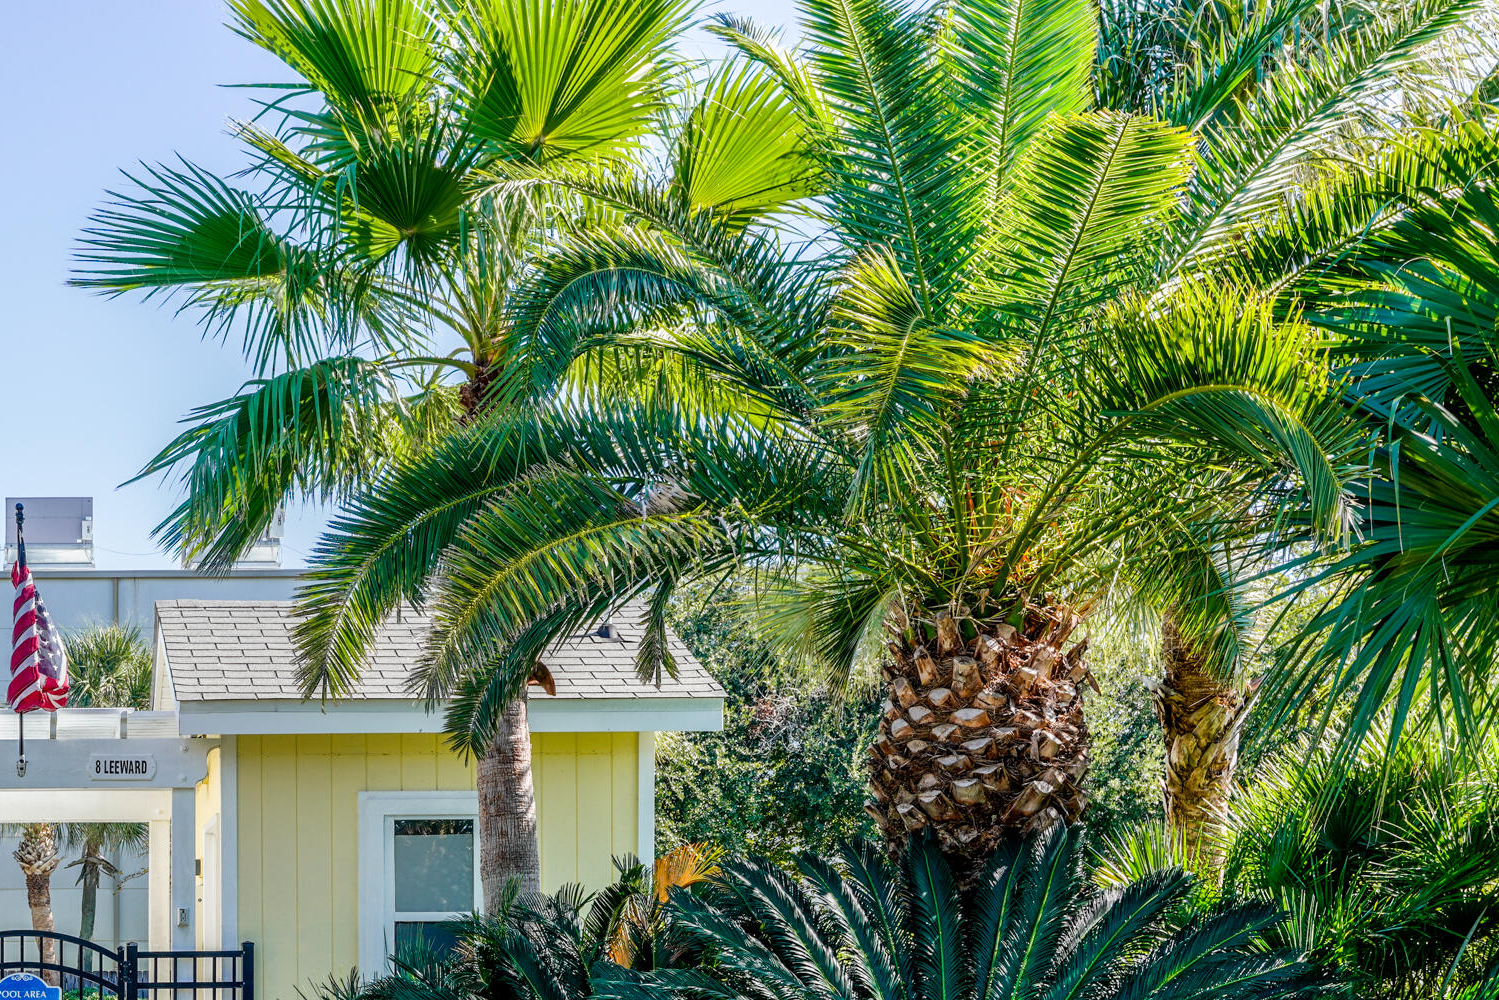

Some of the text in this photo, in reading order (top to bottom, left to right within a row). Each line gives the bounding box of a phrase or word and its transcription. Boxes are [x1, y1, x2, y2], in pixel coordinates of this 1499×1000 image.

[95, 760, 148, 774] 8 LEEWARD
[23, 990, 47, 998] AREA
